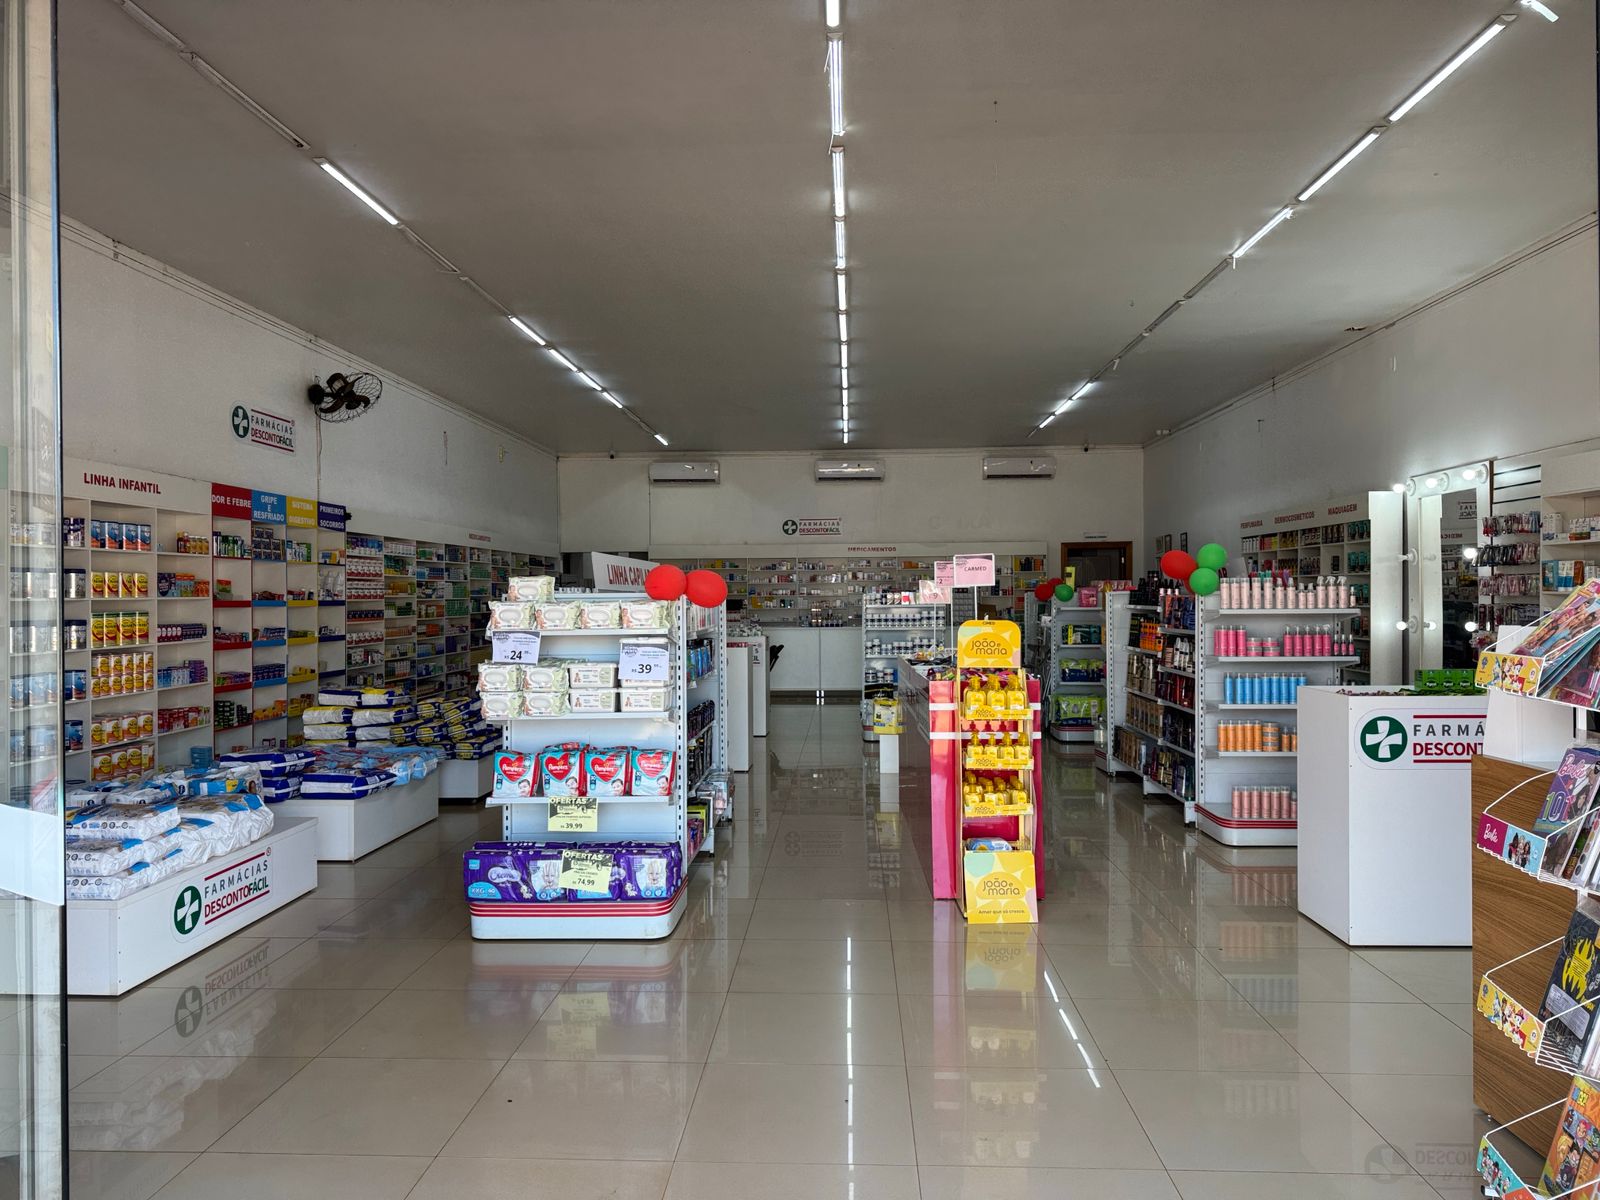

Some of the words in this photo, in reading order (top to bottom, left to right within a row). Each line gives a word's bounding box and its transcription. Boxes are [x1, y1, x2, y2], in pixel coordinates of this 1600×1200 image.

[250, 415, 293, 435] FARMÁCIAS
[250, 428, 294, 448] DESCONTOFÁCIL
[84, 472, 116, 488] LINHA
[118, 478, 161, 494] INFANTIL
[212, 494, 226, 503] DOR
[232, 498, 252, 508] FEBRE
[260, 495, 278, 504] GRIPE
[253, 510, 284, 522] RESFRIADO
[319, 505, 344, 516] PRIMEIROS
[1328, 504, 1358, 516] MAQUIAGEM
[319, 518, 345, 530] SOCORROS
[607, 564, 630, 586] LINHA
[510, 650, 522, 660] 24
[638, 664, 652, 674] 39
[594, 764, 614, 772] Pampers
[1558, 754, 1586, 778] Barbie
[1483, 824, 1498, 842] Barbie
[564, 850, 603, 860] OFERTAS
[204, 860, 268, 898] FARMÁCIAS
[578, 878, 595, 886] 74,99
[204, 876, 269, 918] DESCONTOFÁCIL
